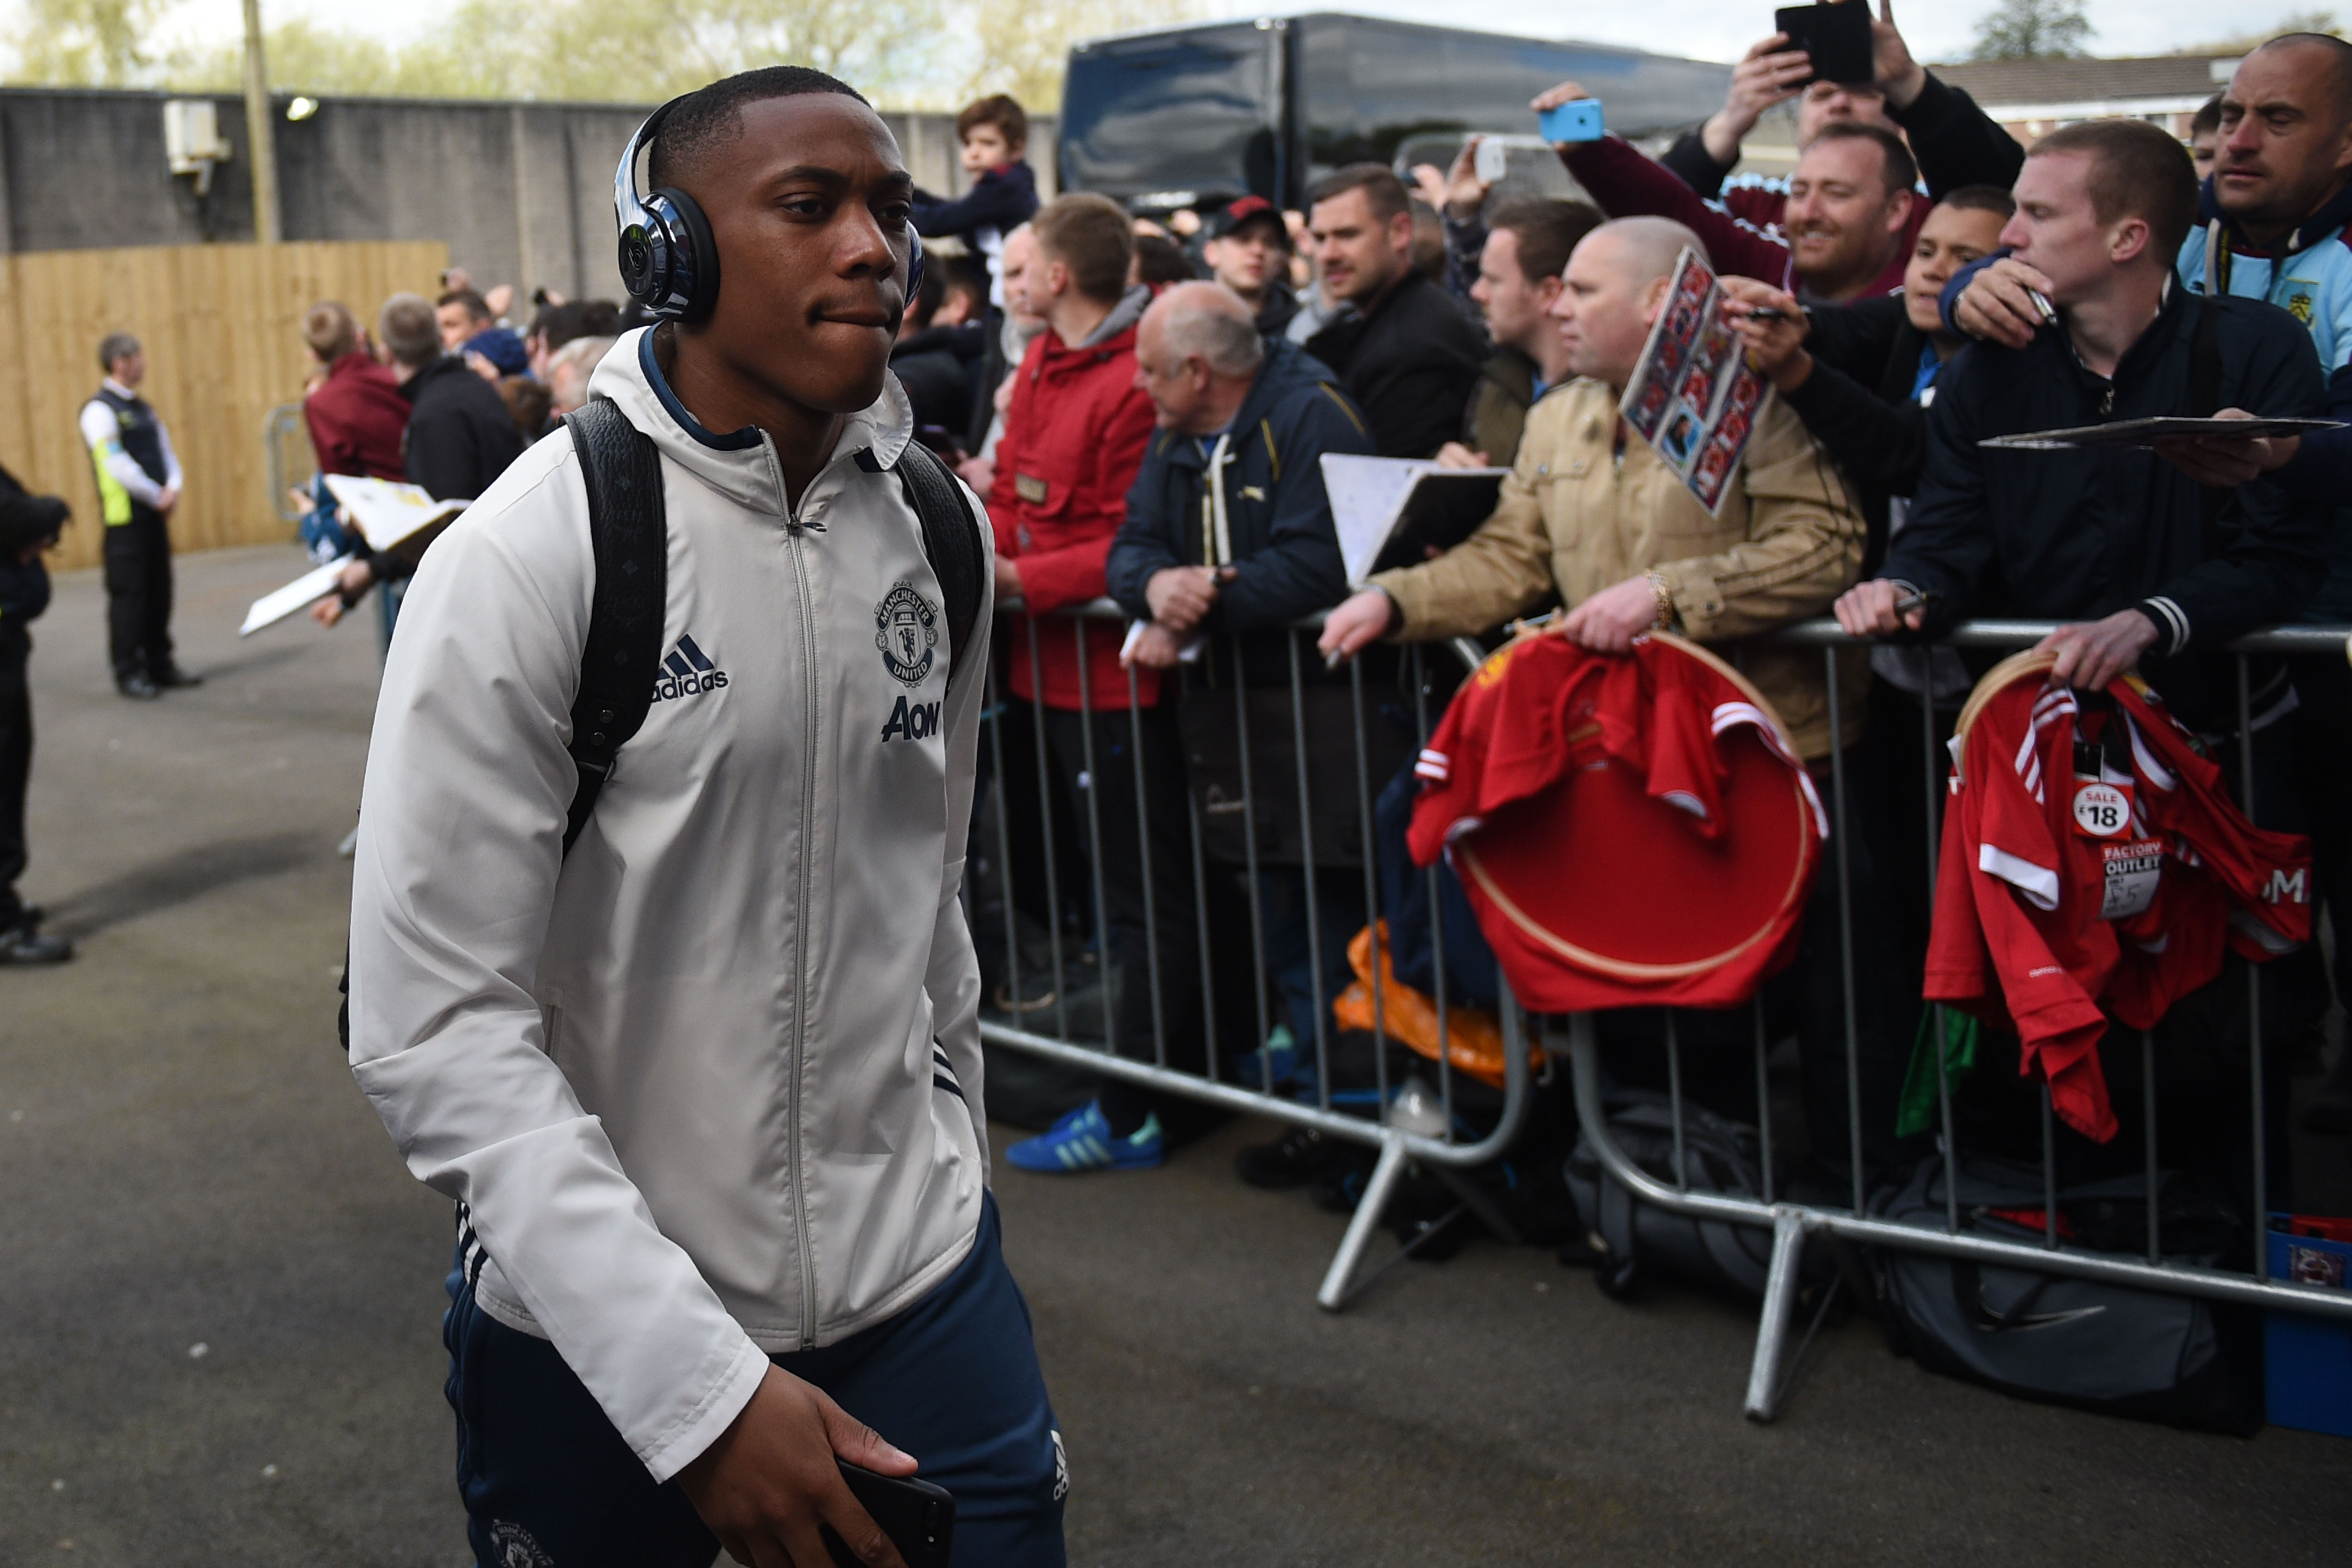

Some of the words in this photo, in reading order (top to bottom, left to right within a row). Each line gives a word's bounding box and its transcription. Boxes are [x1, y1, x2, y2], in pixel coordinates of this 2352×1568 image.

[880, 589, 929, 623] MANCHESTER
[894, 661, 927, 680] UNITED
[650, 671, 729, 703] adidas
[2086, 791, 2117, 803] SALE
[2103, 841, 2161, 858] FACTORY
[2106, 858, 2160, 875] OUTLET
